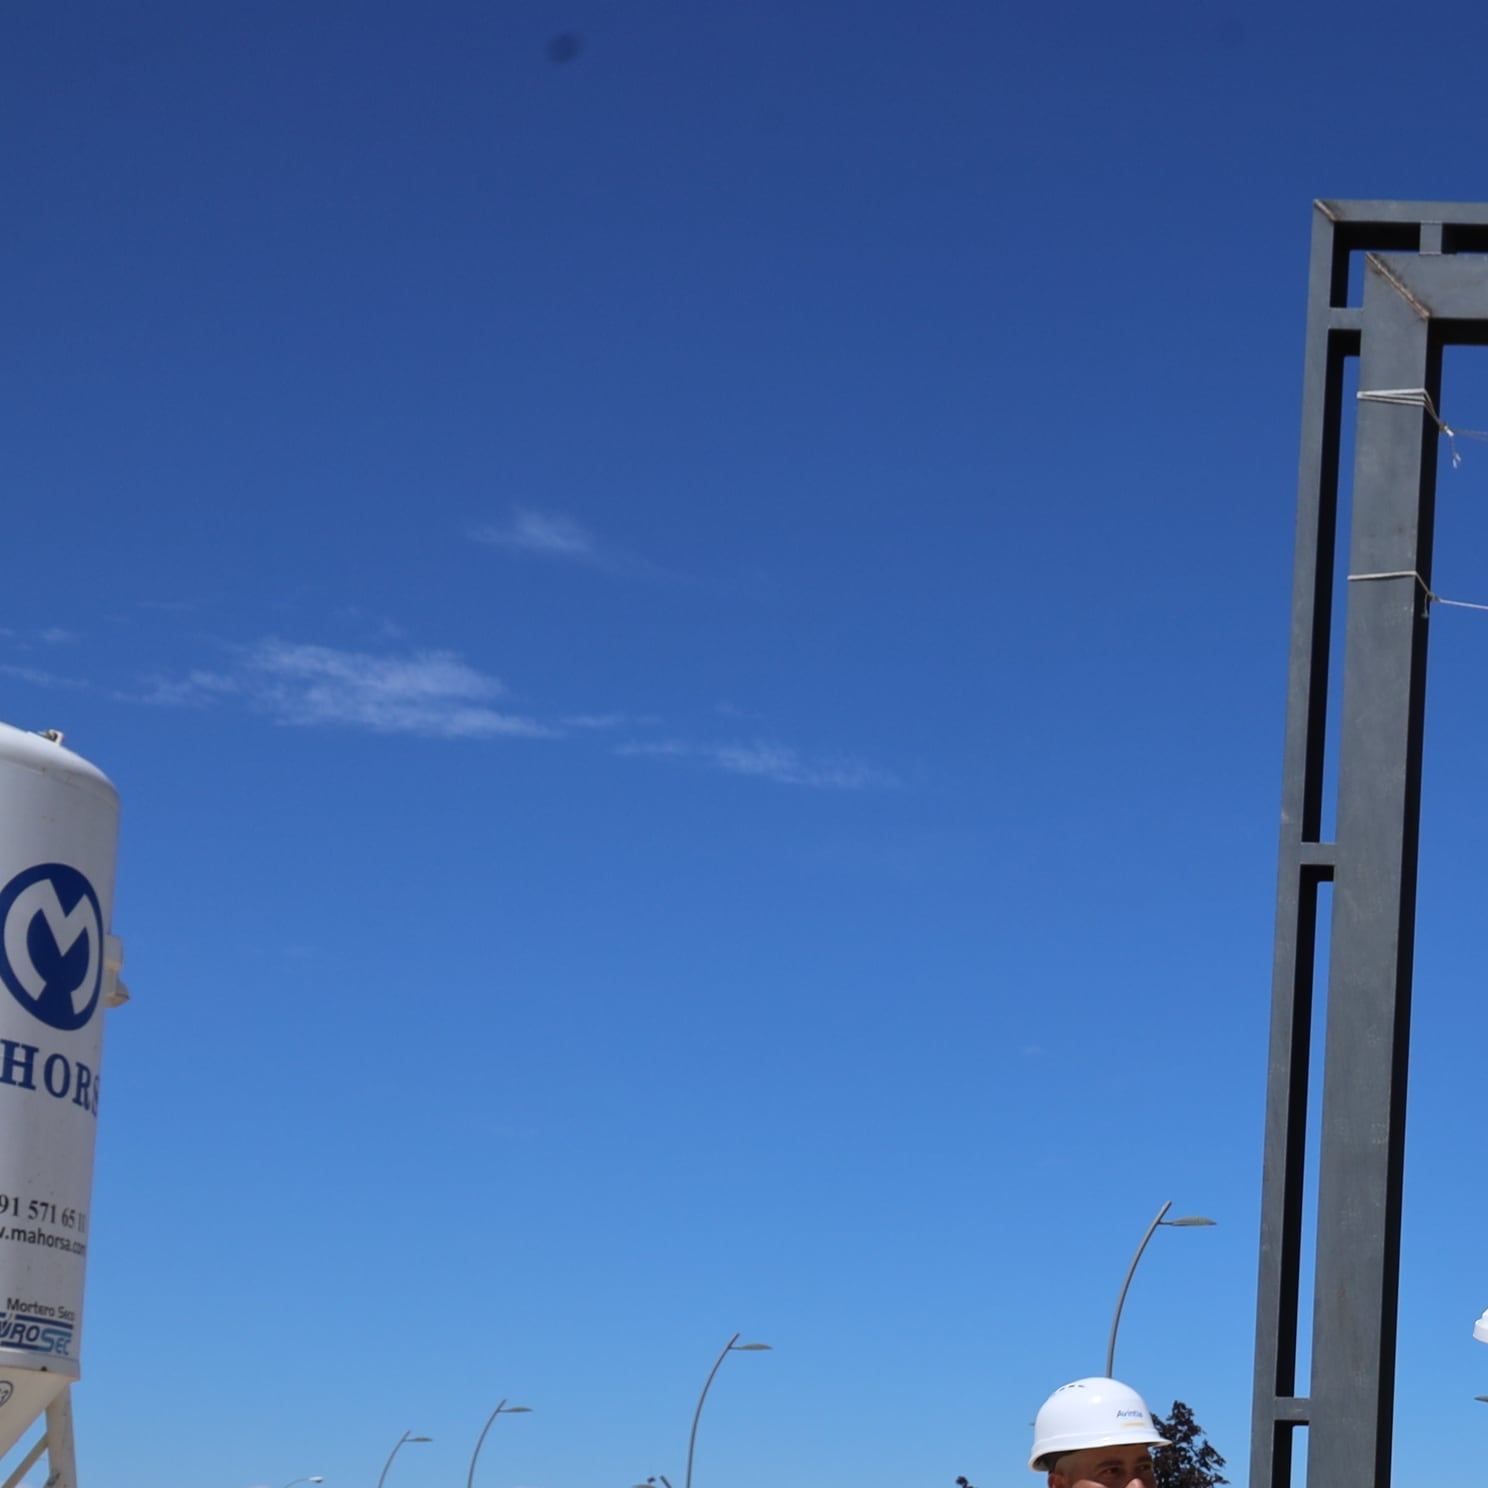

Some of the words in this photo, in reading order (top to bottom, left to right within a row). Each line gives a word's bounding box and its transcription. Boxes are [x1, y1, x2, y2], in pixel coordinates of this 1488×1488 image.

[28, 1200, 56, 1224] 571
[61, 1208, 76, 1229] 65
[6, 1297, 55, 1317] Mortero
